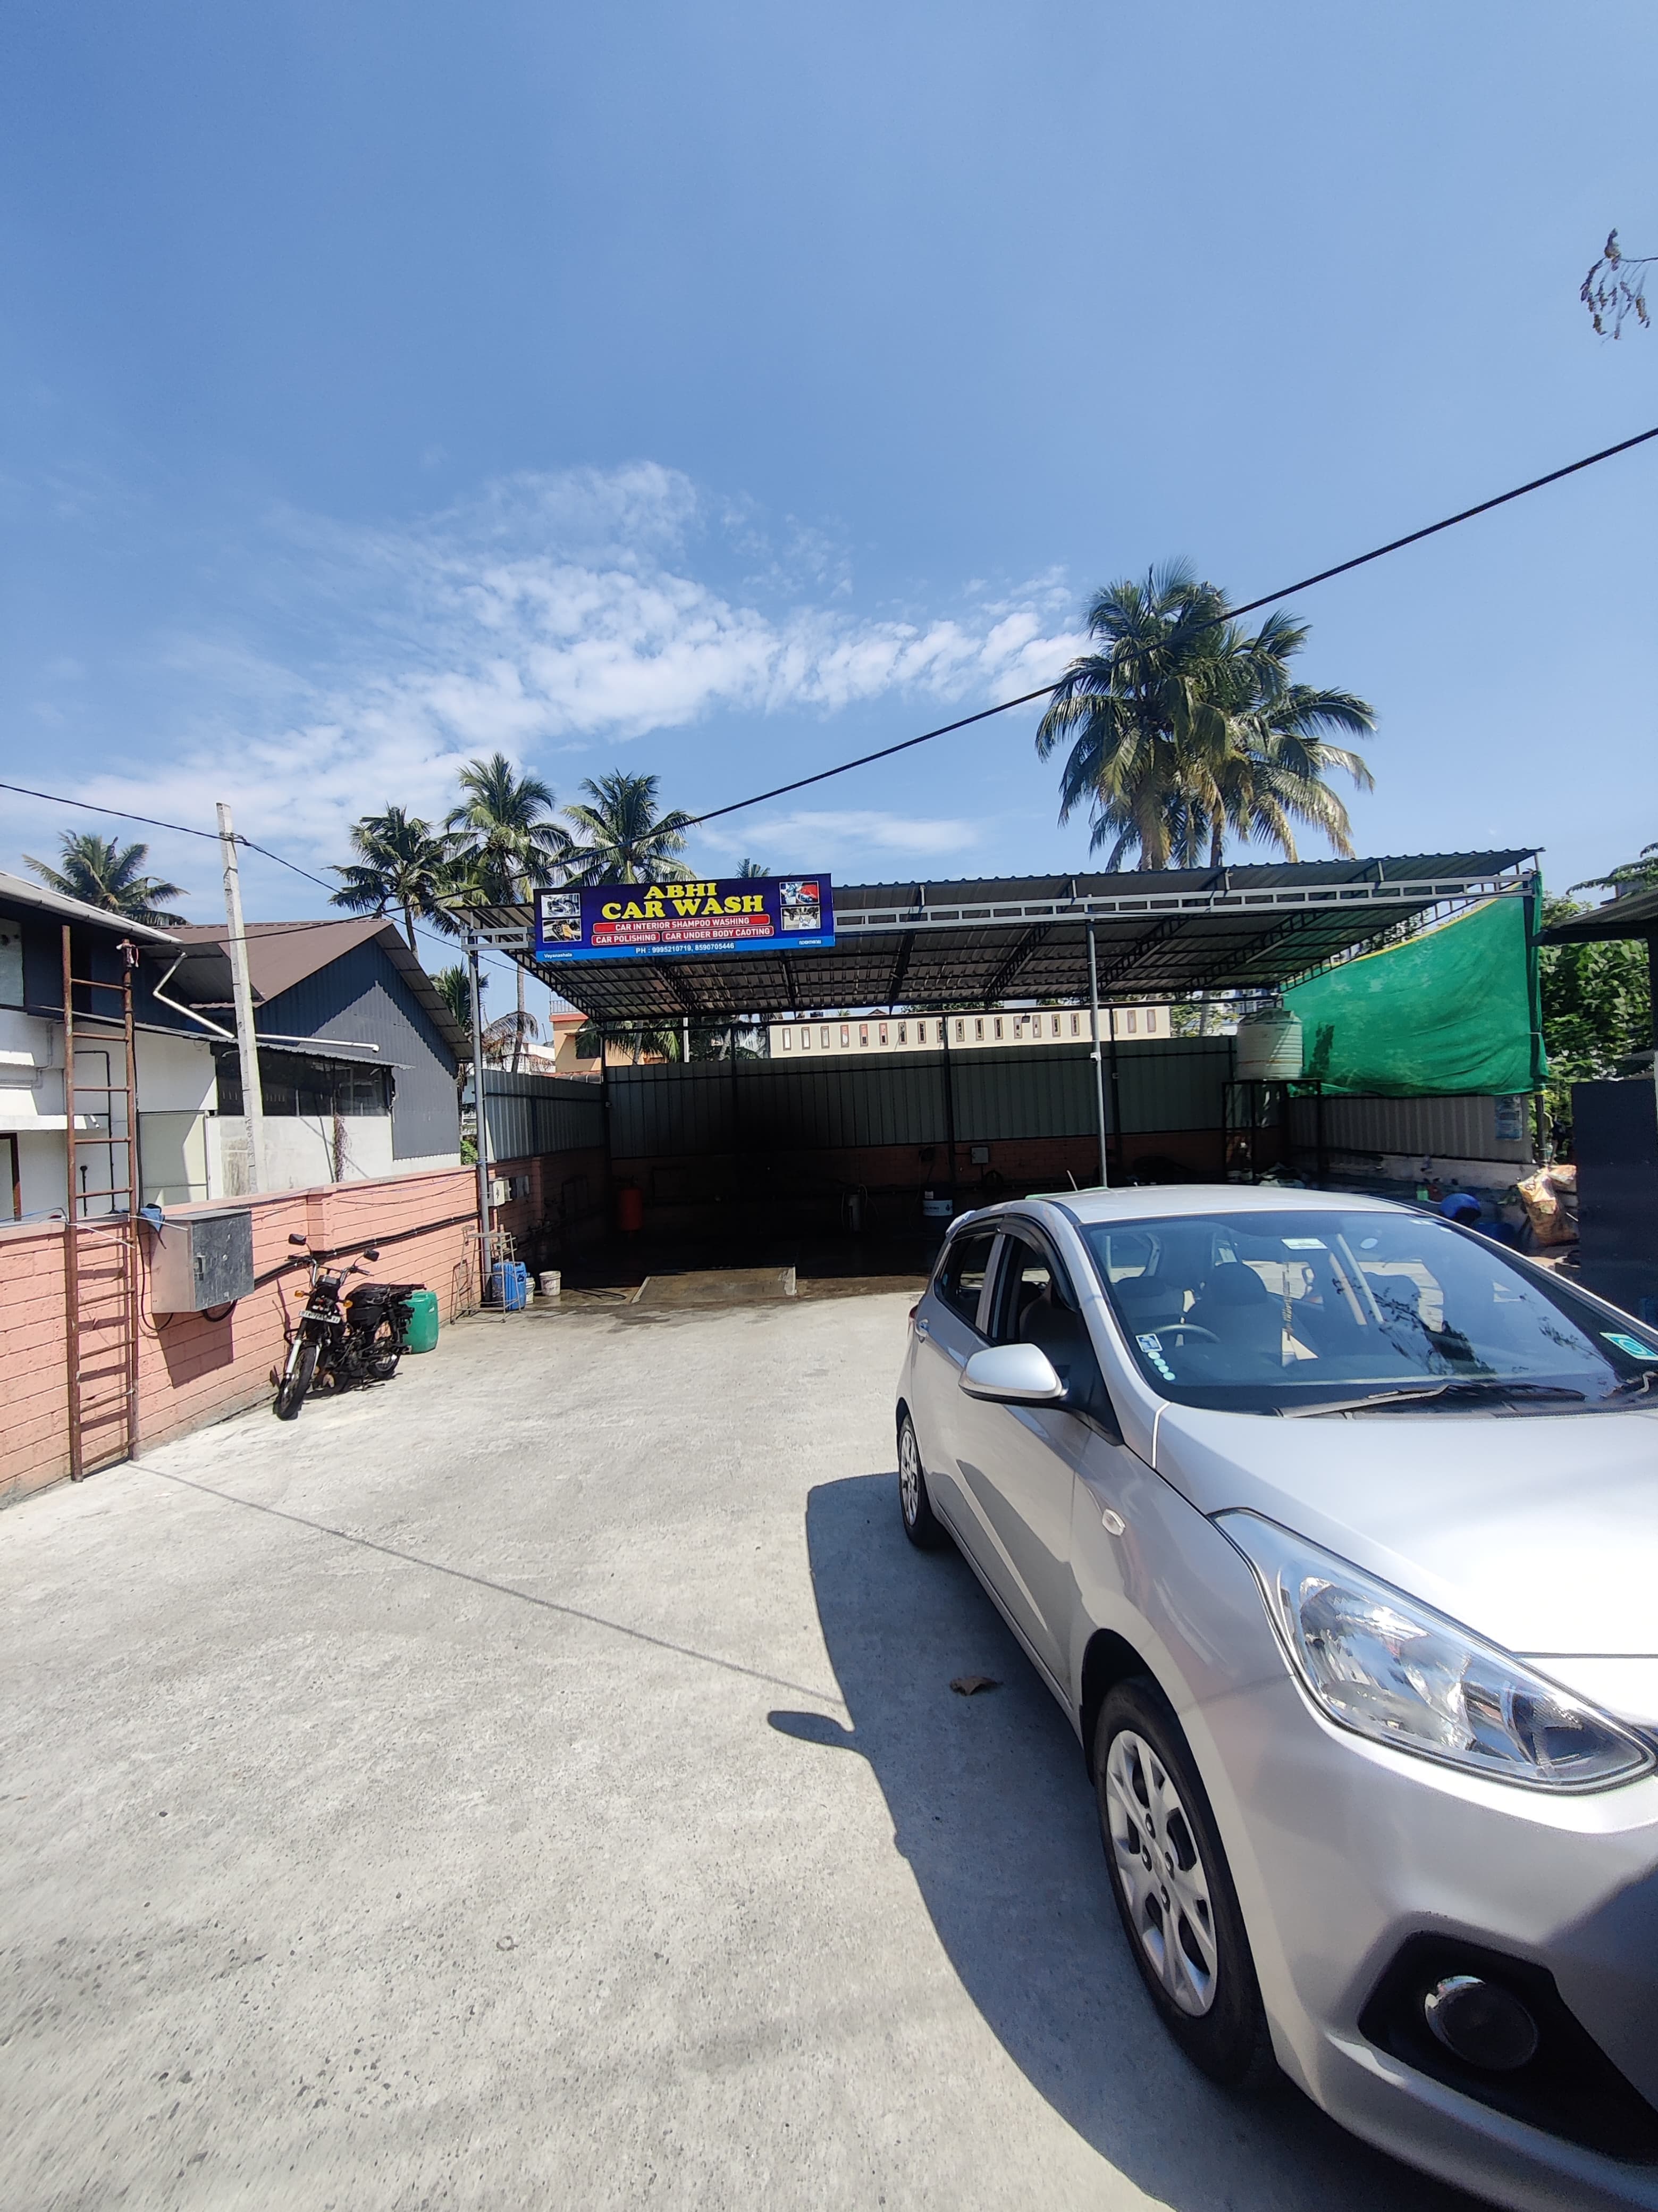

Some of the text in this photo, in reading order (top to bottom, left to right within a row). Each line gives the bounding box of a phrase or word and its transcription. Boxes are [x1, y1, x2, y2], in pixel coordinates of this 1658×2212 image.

[643, 883, 717, 899] ABHI
[601, 895, 764, 920] CAR WASH
[633, 921, 670, 930] INTERIOR
[671, 919, 710, 928] SHAMPOO
[712, 917, 750, 926] WASHING
[613, 933, 657, 943] POLISHING
[683, 931, 711, 939] UNDER
[712, 929, 736, 937] BODY
[735, 927, 770, 936] CAOTING
[652, 944, 693, 953] 9995210719,
[694, 942, 735, 951] 8590705446
